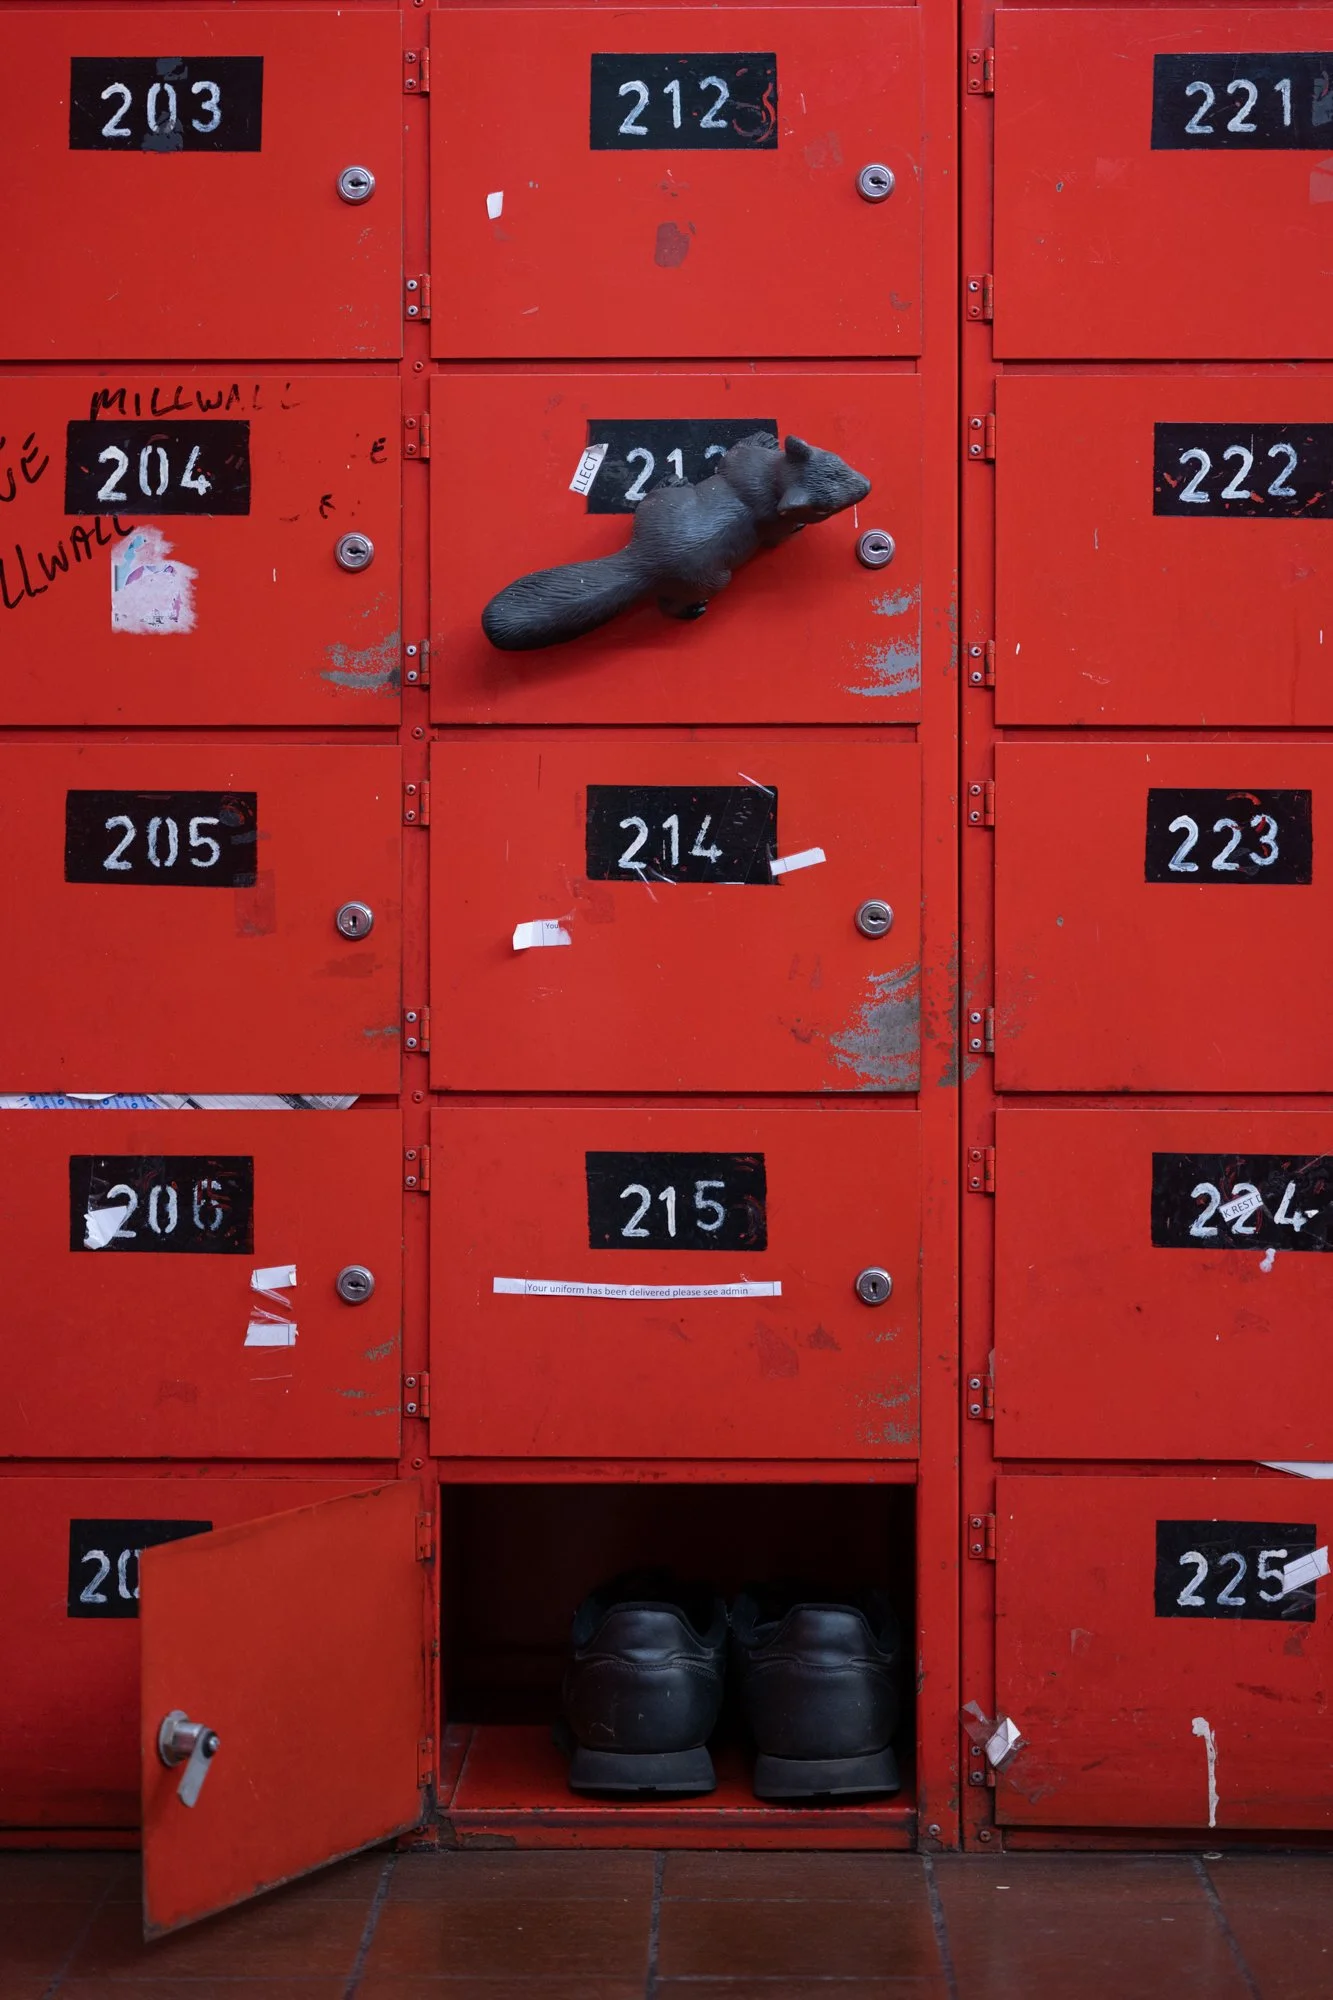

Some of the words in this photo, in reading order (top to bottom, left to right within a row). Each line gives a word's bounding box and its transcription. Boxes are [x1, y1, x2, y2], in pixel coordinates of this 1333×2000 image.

[101, 81, 222, 137] 203
[619, 76, 729, 135] 212
[1185, 78, 1291, 133] 221
[97, 445, 212, 502] 204
[1179, 443, 1298, 502] 222
[103, 815, 221, 870] 205
[618, 814, 723, 869] 214
[1168, 814, 1279, 872] 223
[107, 1179, 223, 1239] 206
[620, 1180, 726, 1237] 215
[1190, 1180, 1307, 1237] 224
[1232, 1197, 1254, 1214] REST
[527, 1283, 547, 1292] Your
[550, 1285, 584, 1294] uniform
[587, 1286, 602, 1295] has
[604, 1287, 627, 1296] been
[629, 1288, 670, 1297] delivered
[672, 1288, 701, 1298] please
[720, 1286, 748, 1296] admin
[1177, 1549, 1288, 1607] 225
